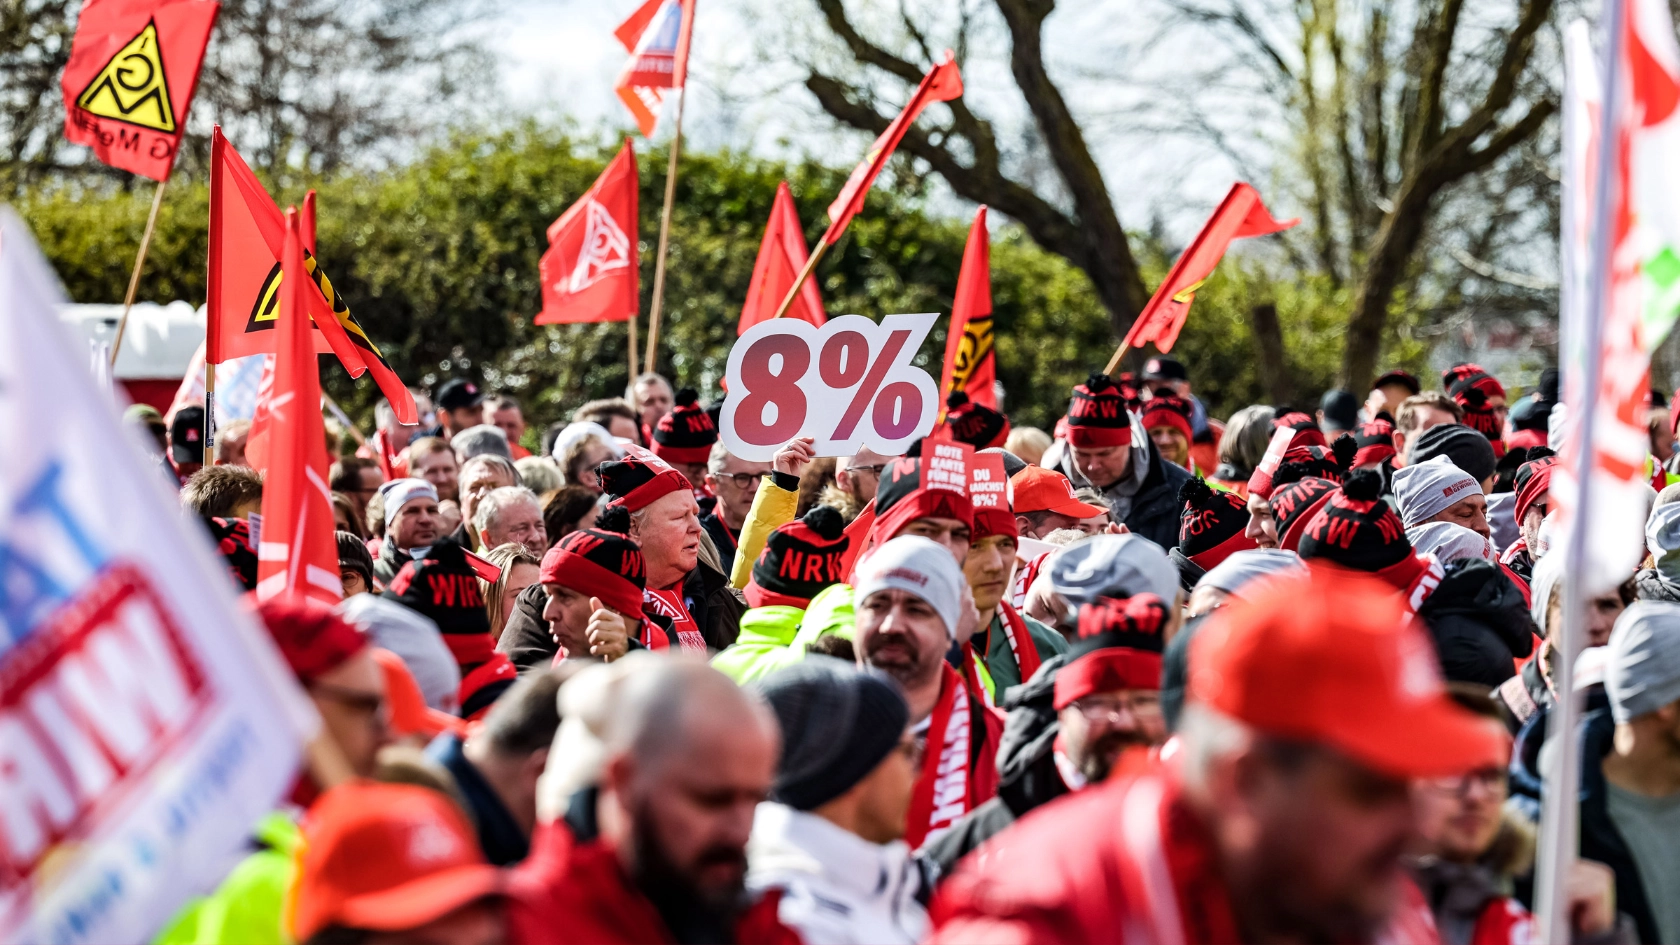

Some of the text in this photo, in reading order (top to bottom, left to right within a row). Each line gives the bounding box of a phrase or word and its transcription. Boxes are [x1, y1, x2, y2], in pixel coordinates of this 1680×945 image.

[733, 329, 923, 446] 8%
[1069, 396, 1119, 418] NRW
[934, 444, 963, 461] ROTE
[930, 456, 966, 474] KARTE
[973, 468, 991, 482] DU
[926, 467, 967, 488] FÜR DIE
[972, 493, 998, 508] 8%?
[1272, 478, 1328, 521] WIR
[1182, 508, 1220, 540] FÜR
[1304, 507, 1361, 550] RW
[427, 573, 484, 608] WIR
